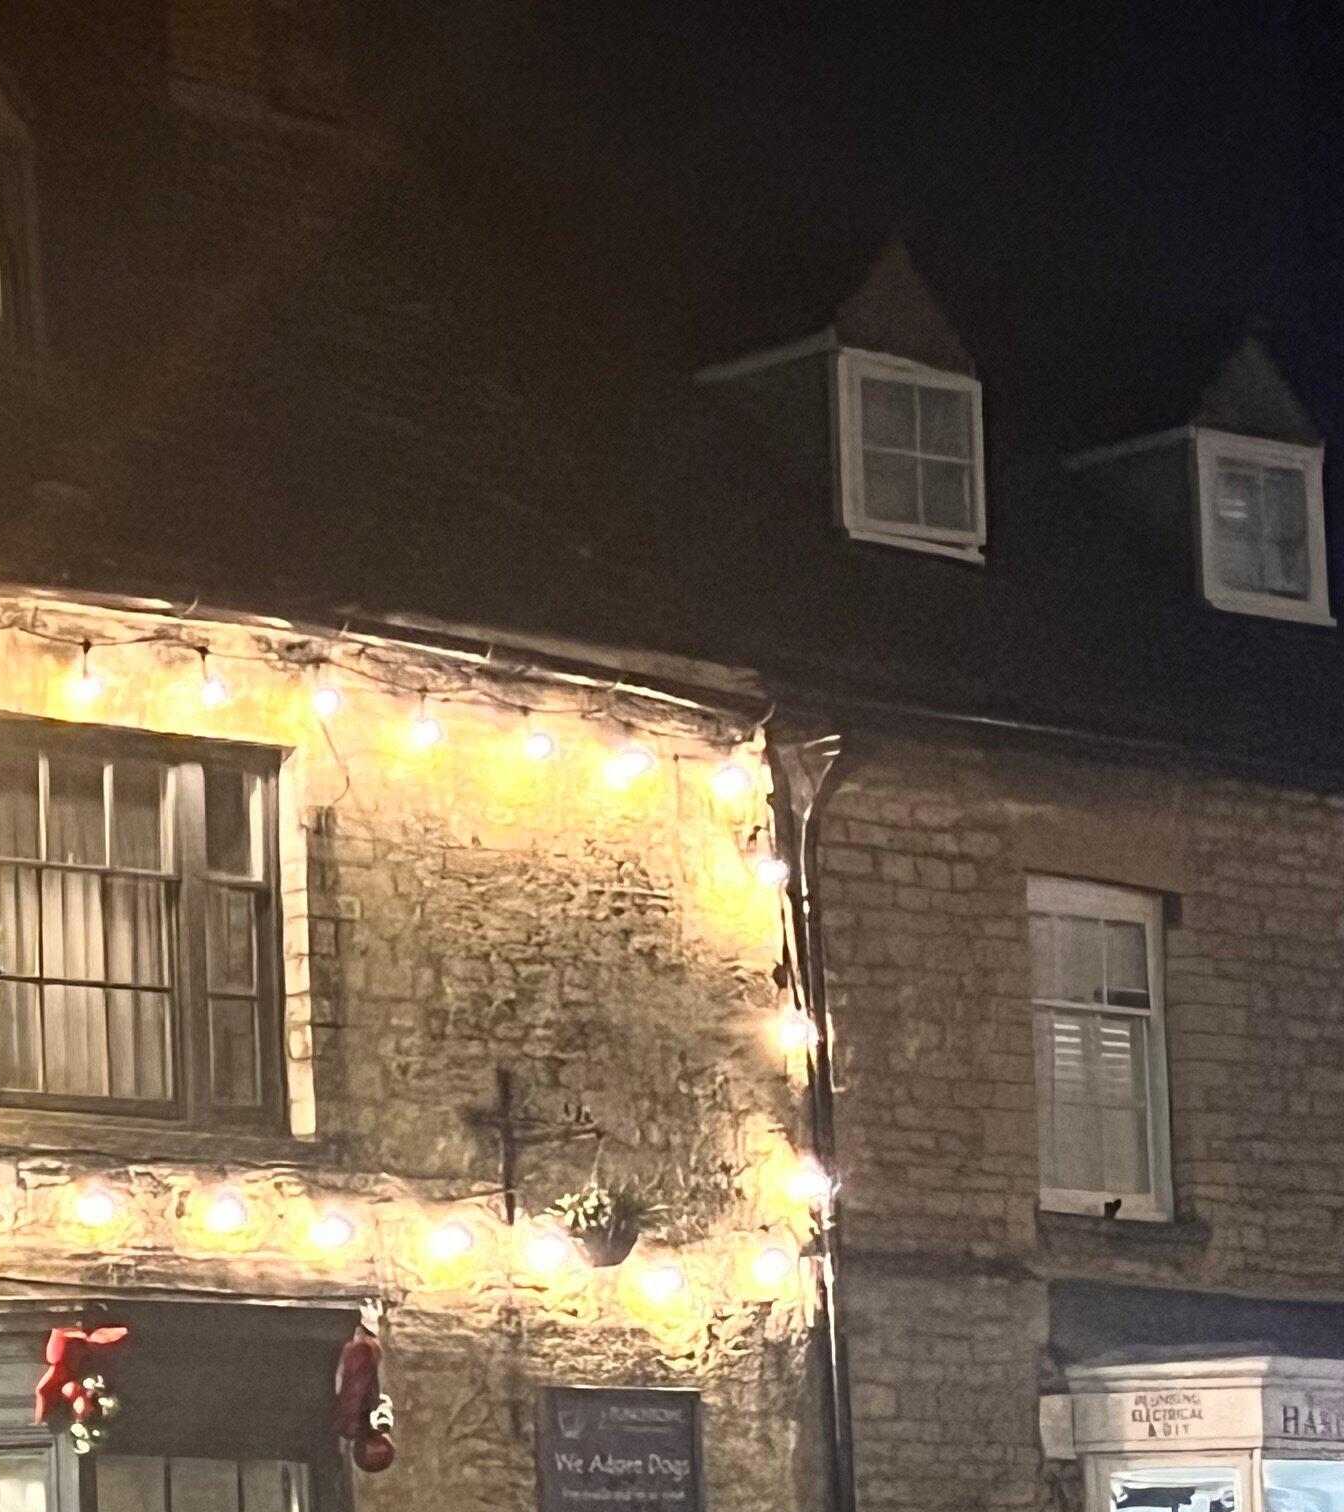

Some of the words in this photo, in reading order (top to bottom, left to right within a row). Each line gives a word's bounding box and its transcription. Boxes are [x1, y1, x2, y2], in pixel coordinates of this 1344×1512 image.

[1163, 1423, 1189, 1437] DIY
[554, 1451, 583, 1474] We
[588, 1453, 643, 1475] Adore
[648, 1453, 690, 1482] Dogs
